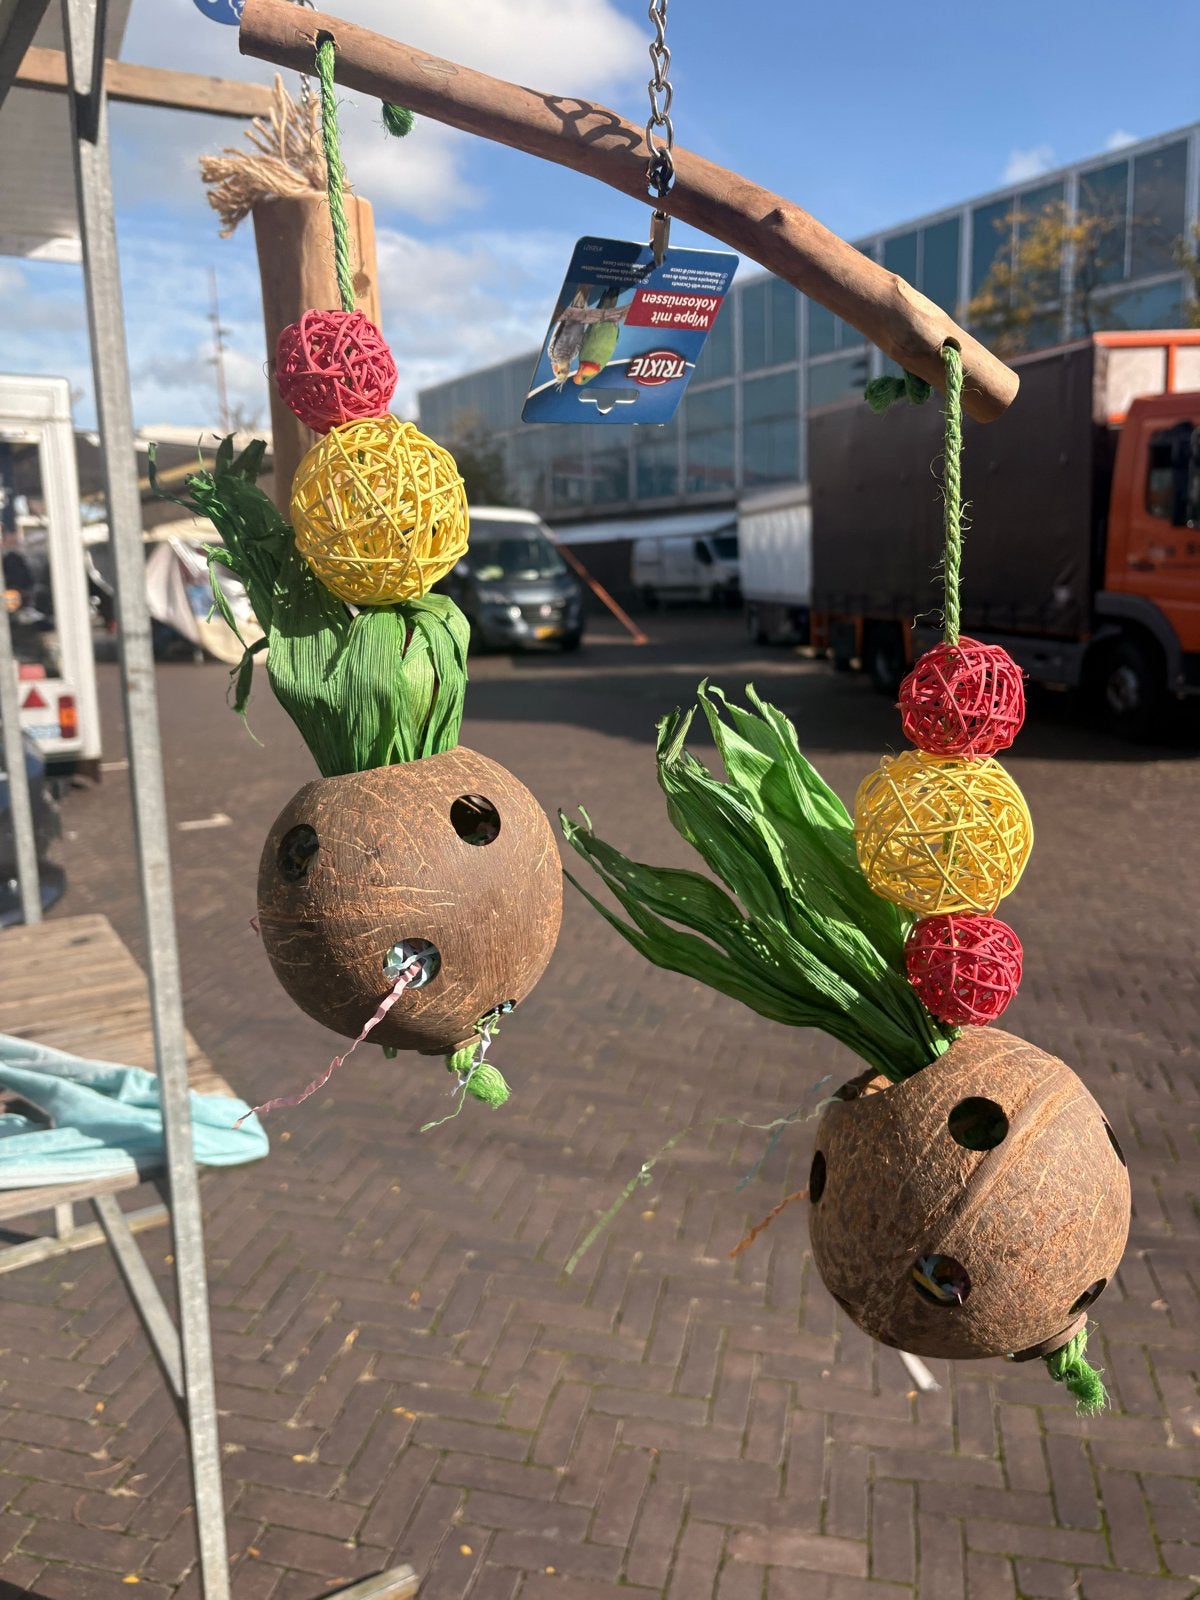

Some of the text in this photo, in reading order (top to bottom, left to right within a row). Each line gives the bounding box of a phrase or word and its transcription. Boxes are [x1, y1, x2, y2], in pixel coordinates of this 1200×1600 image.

[641, 293, 718, 311] Kokosnüssen
[650, 310, 709, 327] Wippe mit
[627, 358, 685, 378] TRIXIE
